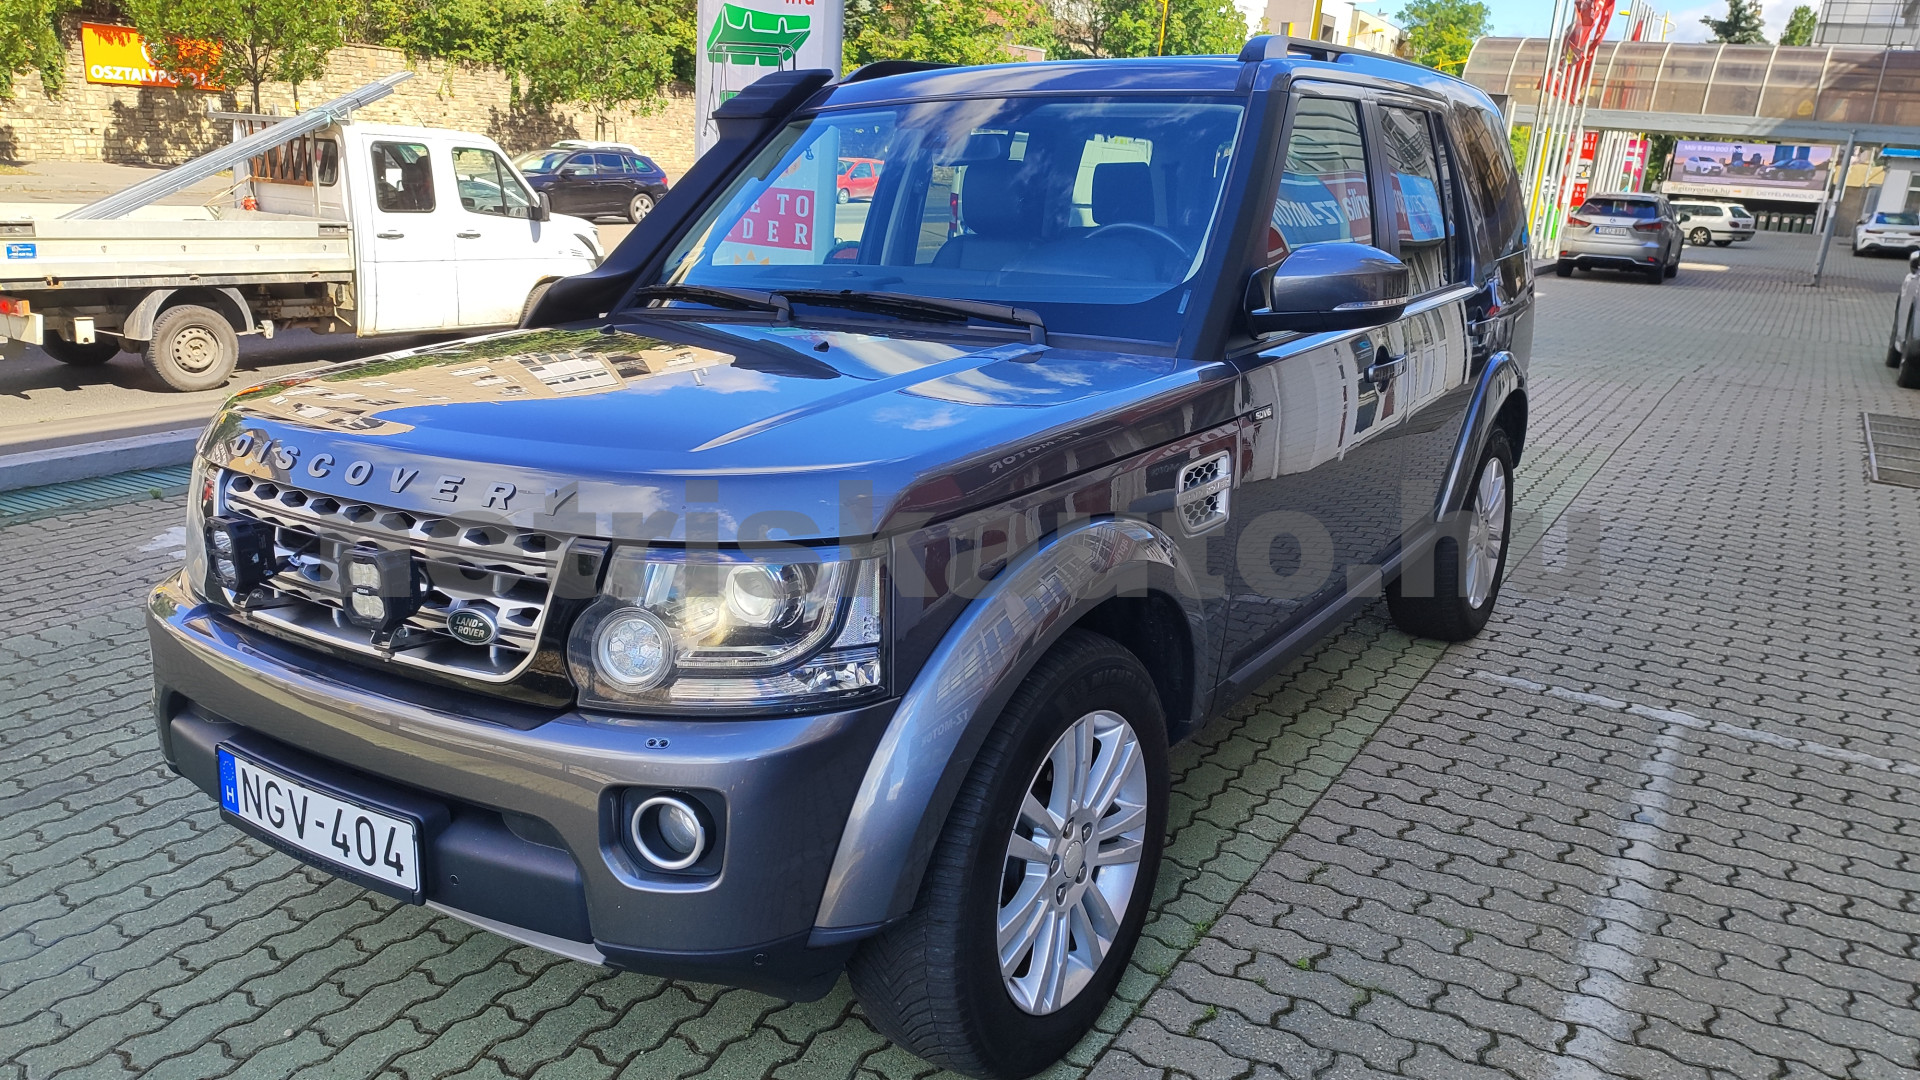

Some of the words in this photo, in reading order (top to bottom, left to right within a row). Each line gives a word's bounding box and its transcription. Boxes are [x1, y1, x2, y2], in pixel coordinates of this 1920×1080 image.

[776, 193, 809, 218] TO
[727, 218, 808, 245] DER
[231, 435, 577, 516] DISCOVERY
[456, 616, 479, 627] LAND
[457, 625, 485, 638] ROVER
[225, 785, 235, 804] H
[241, 767, 404, 877] NGV-404
